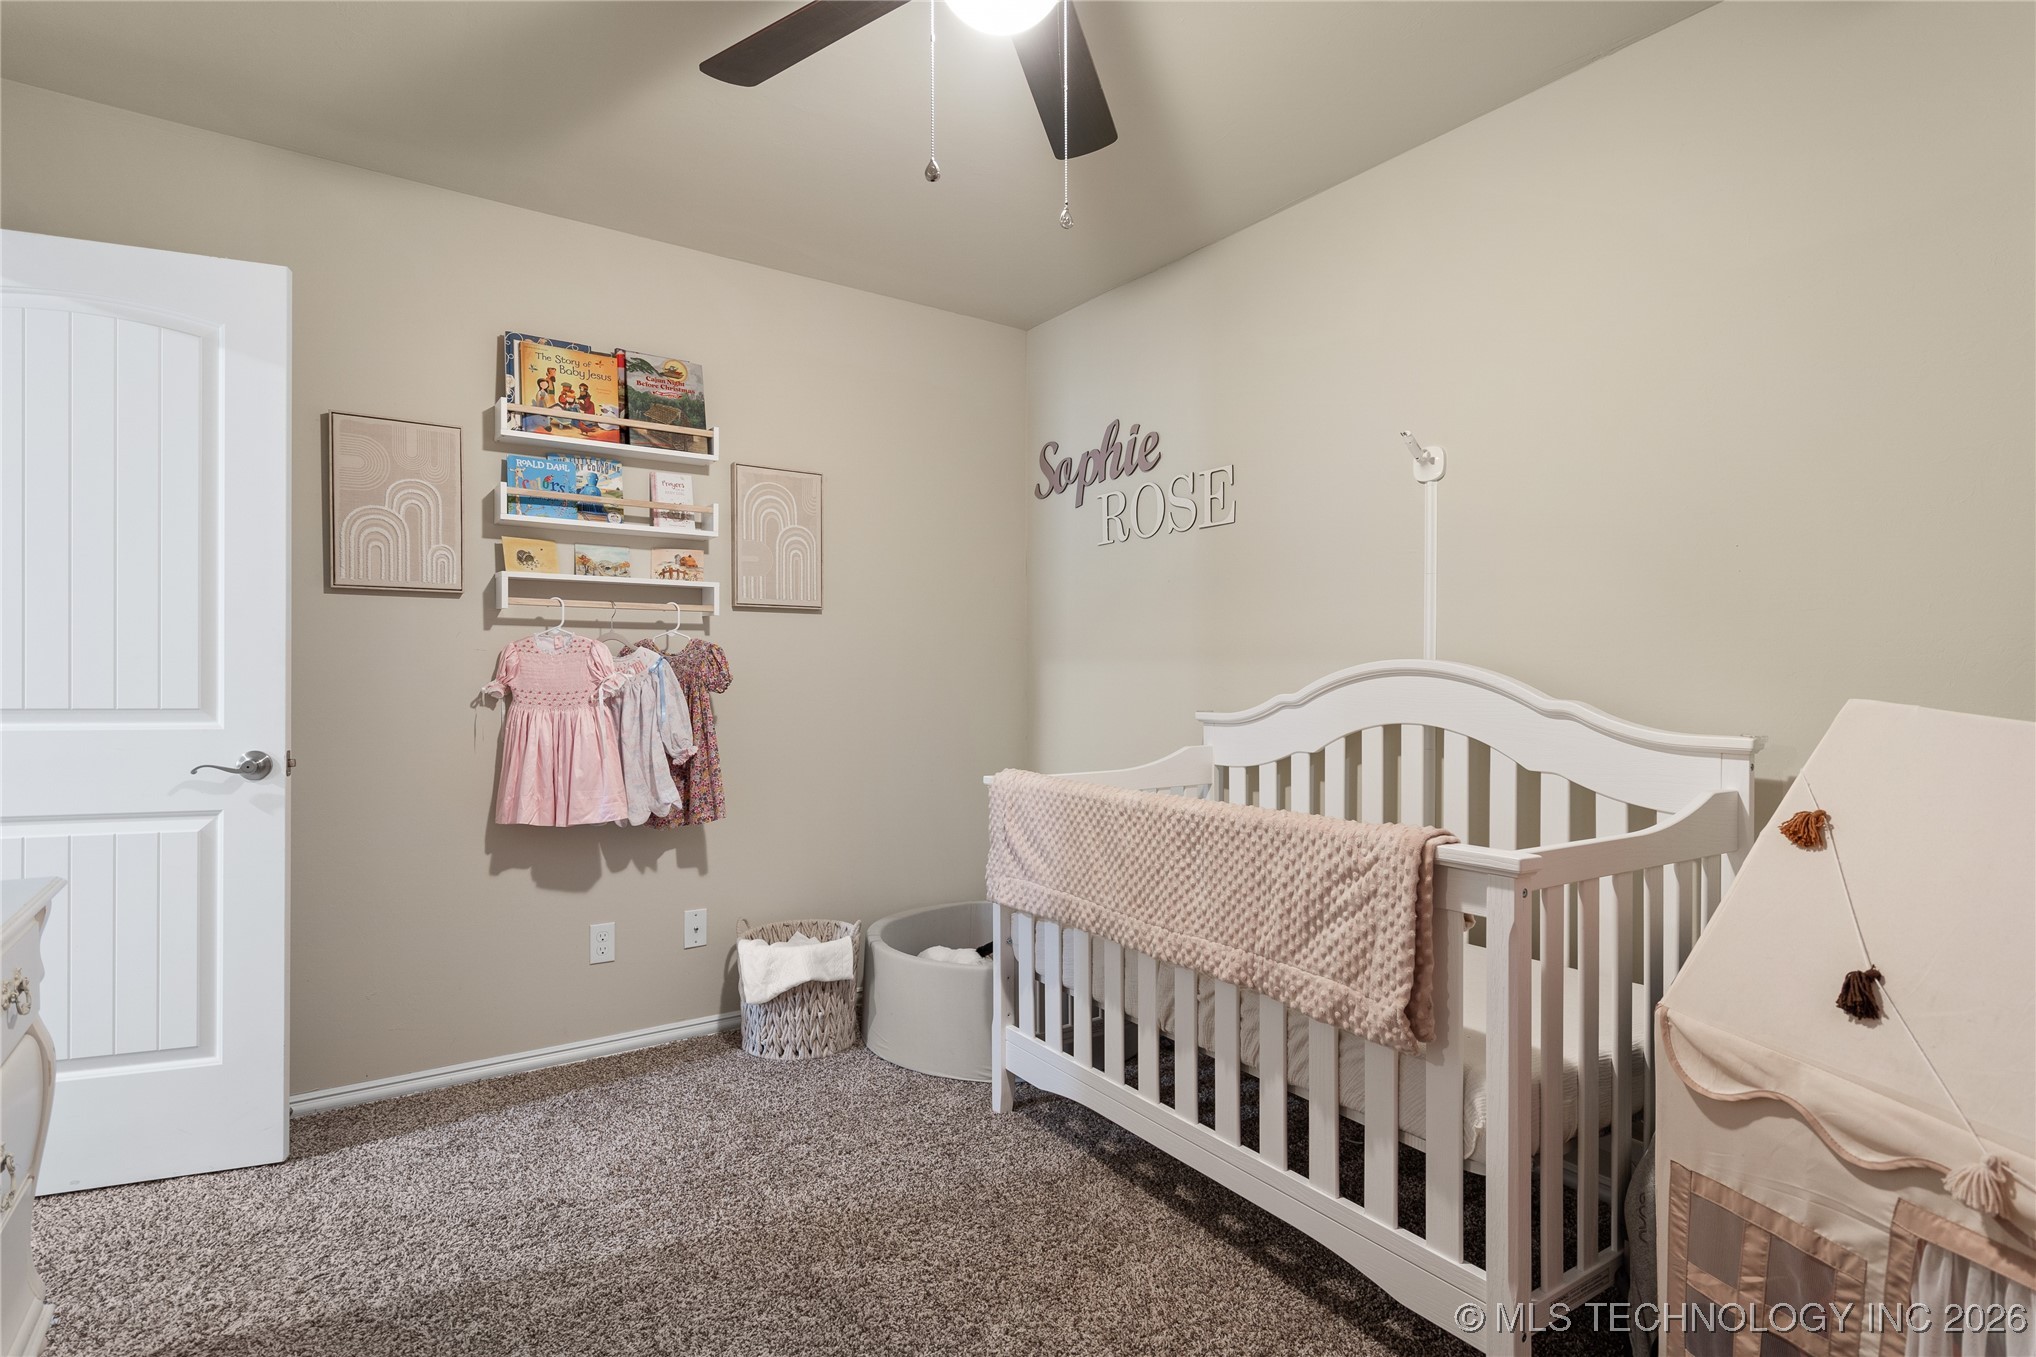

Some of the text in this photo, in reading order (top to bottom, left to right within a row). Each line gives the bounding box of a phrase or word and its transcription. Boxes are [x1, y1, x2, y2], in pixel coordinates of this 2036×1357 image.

[535, 352, 552, 362] The
[555, 355, 580, 368] Story
[559, 365, 612, 382] Baby Jesus
[636, 380, 696, 394] Before Christmas
[645, 375, 685, 387] Cajun Night
[516, 459, 570, 472] ROALD DAHL
[587, 464, 609, 475] COULD
[1034, 419, 1162, 509] Sophie
[661, 480, 685, 490] Prayers
[1097, 464, 1236, 546] ROSE
